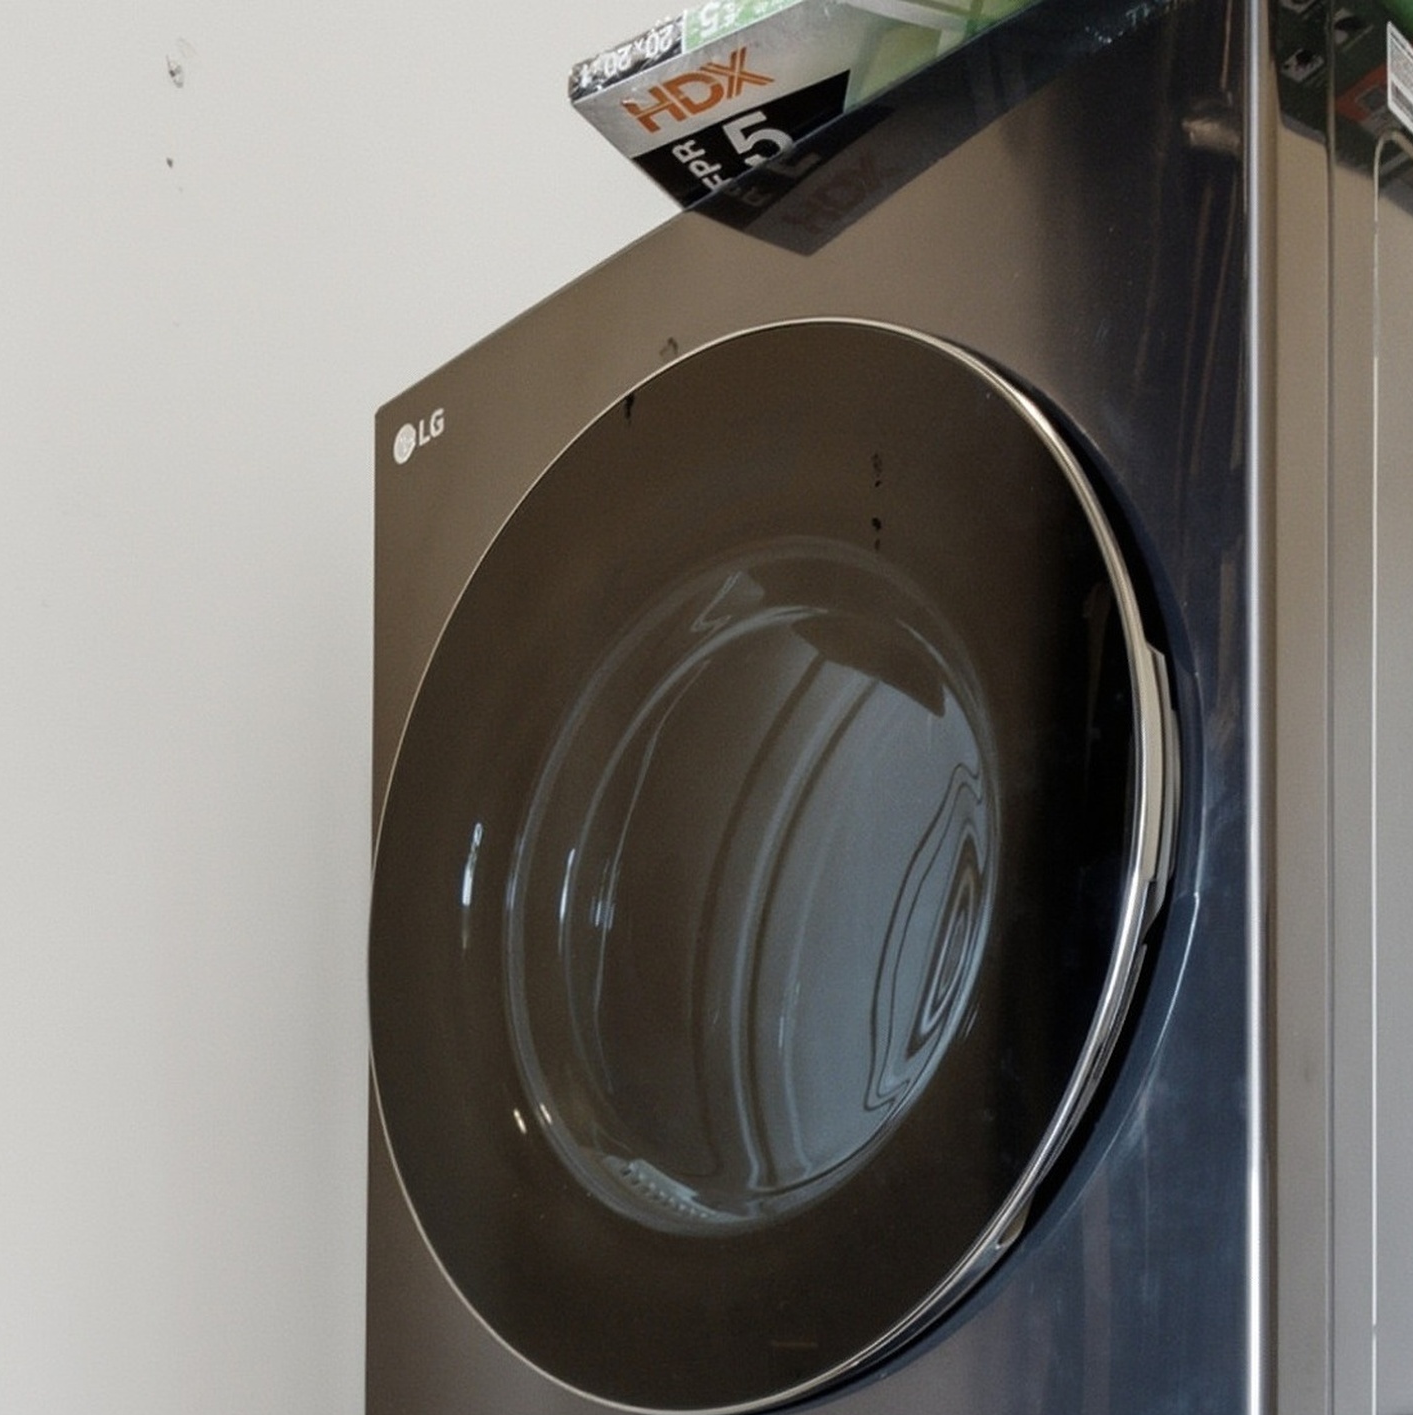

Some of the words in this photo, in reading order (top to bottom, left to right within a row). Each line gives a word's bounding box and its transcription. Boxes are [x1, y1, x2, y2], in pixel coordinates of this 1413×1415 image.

[621, 46, 775, 134] HDX
[672, 139, 733, 191] FPR
[722, 110, 793, 168] 5
[418, 407, 445, 446] LG
